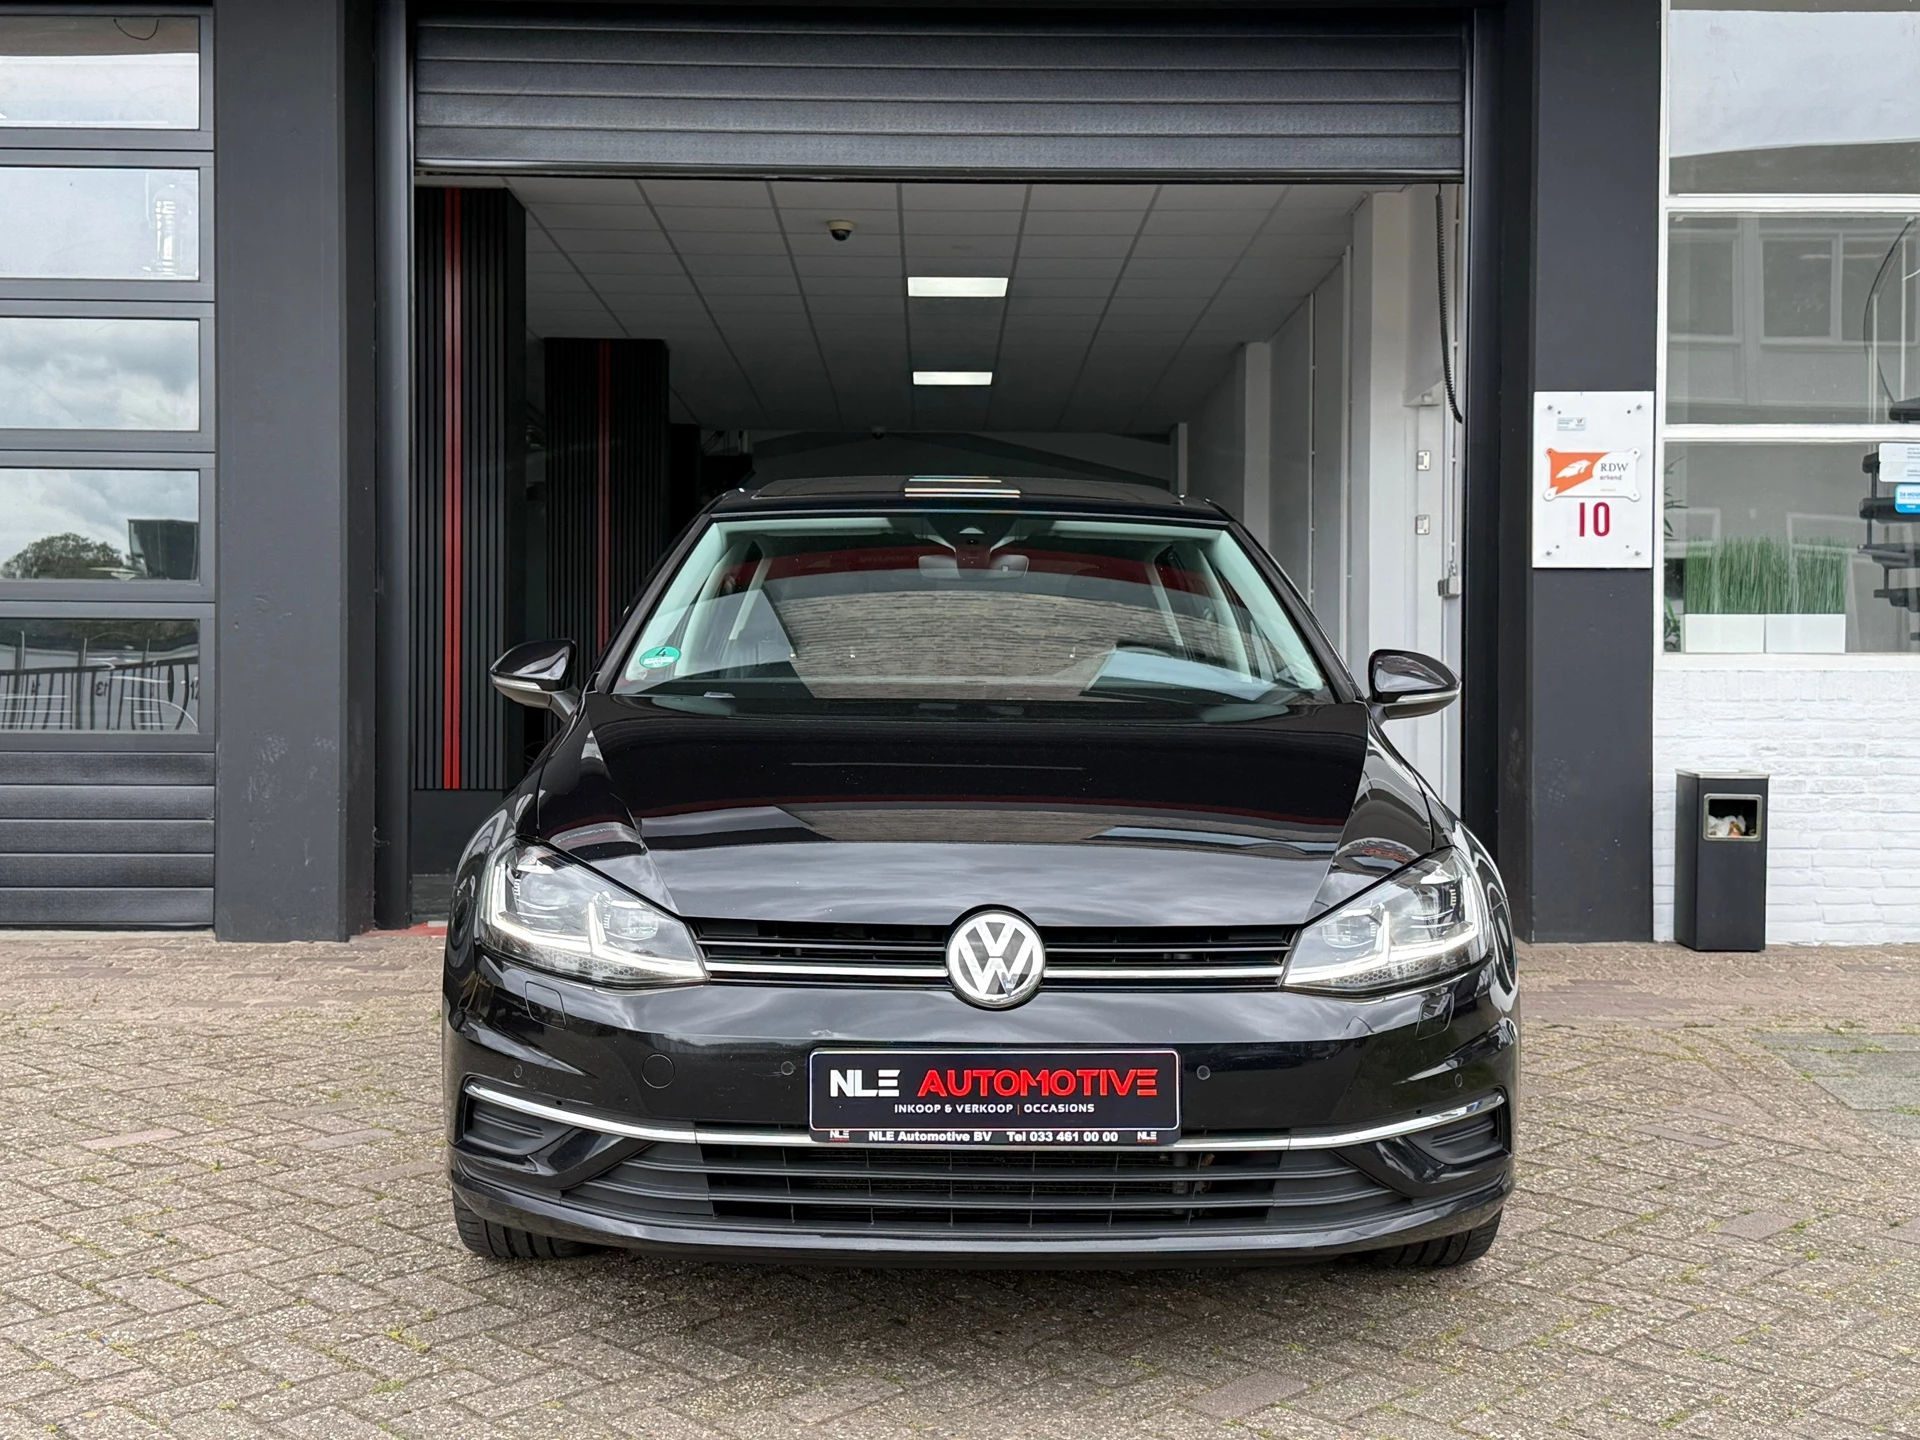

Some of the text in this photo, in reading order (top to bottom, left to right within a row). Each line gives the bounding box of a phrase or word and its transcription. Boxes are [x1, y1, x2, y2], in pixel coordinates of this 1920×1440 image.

[1601, 463, 1628, 472] RDW
[1579, 502, 1610, 537] 10
[655, 647, 667, 657] 4
[830, 1068, 1159, 1097] NLE AUTOMOTIVE
[894, 1104, 941, 1113] INKOOP
[944, 1104, 953, 1113] &
[955, 1103, 1014, 1113] VERKOOP
[1023, 1103, 1095, 1113] OCCASIONS
[829, 1130, 850, 1139] NLE
[868, 1131, 993, 1142] NLE Automotive BV
[1006, 1131, 1119, 1142] Tel 033 461 00 00
[1137, 1131, 1158, 1140] NLE
